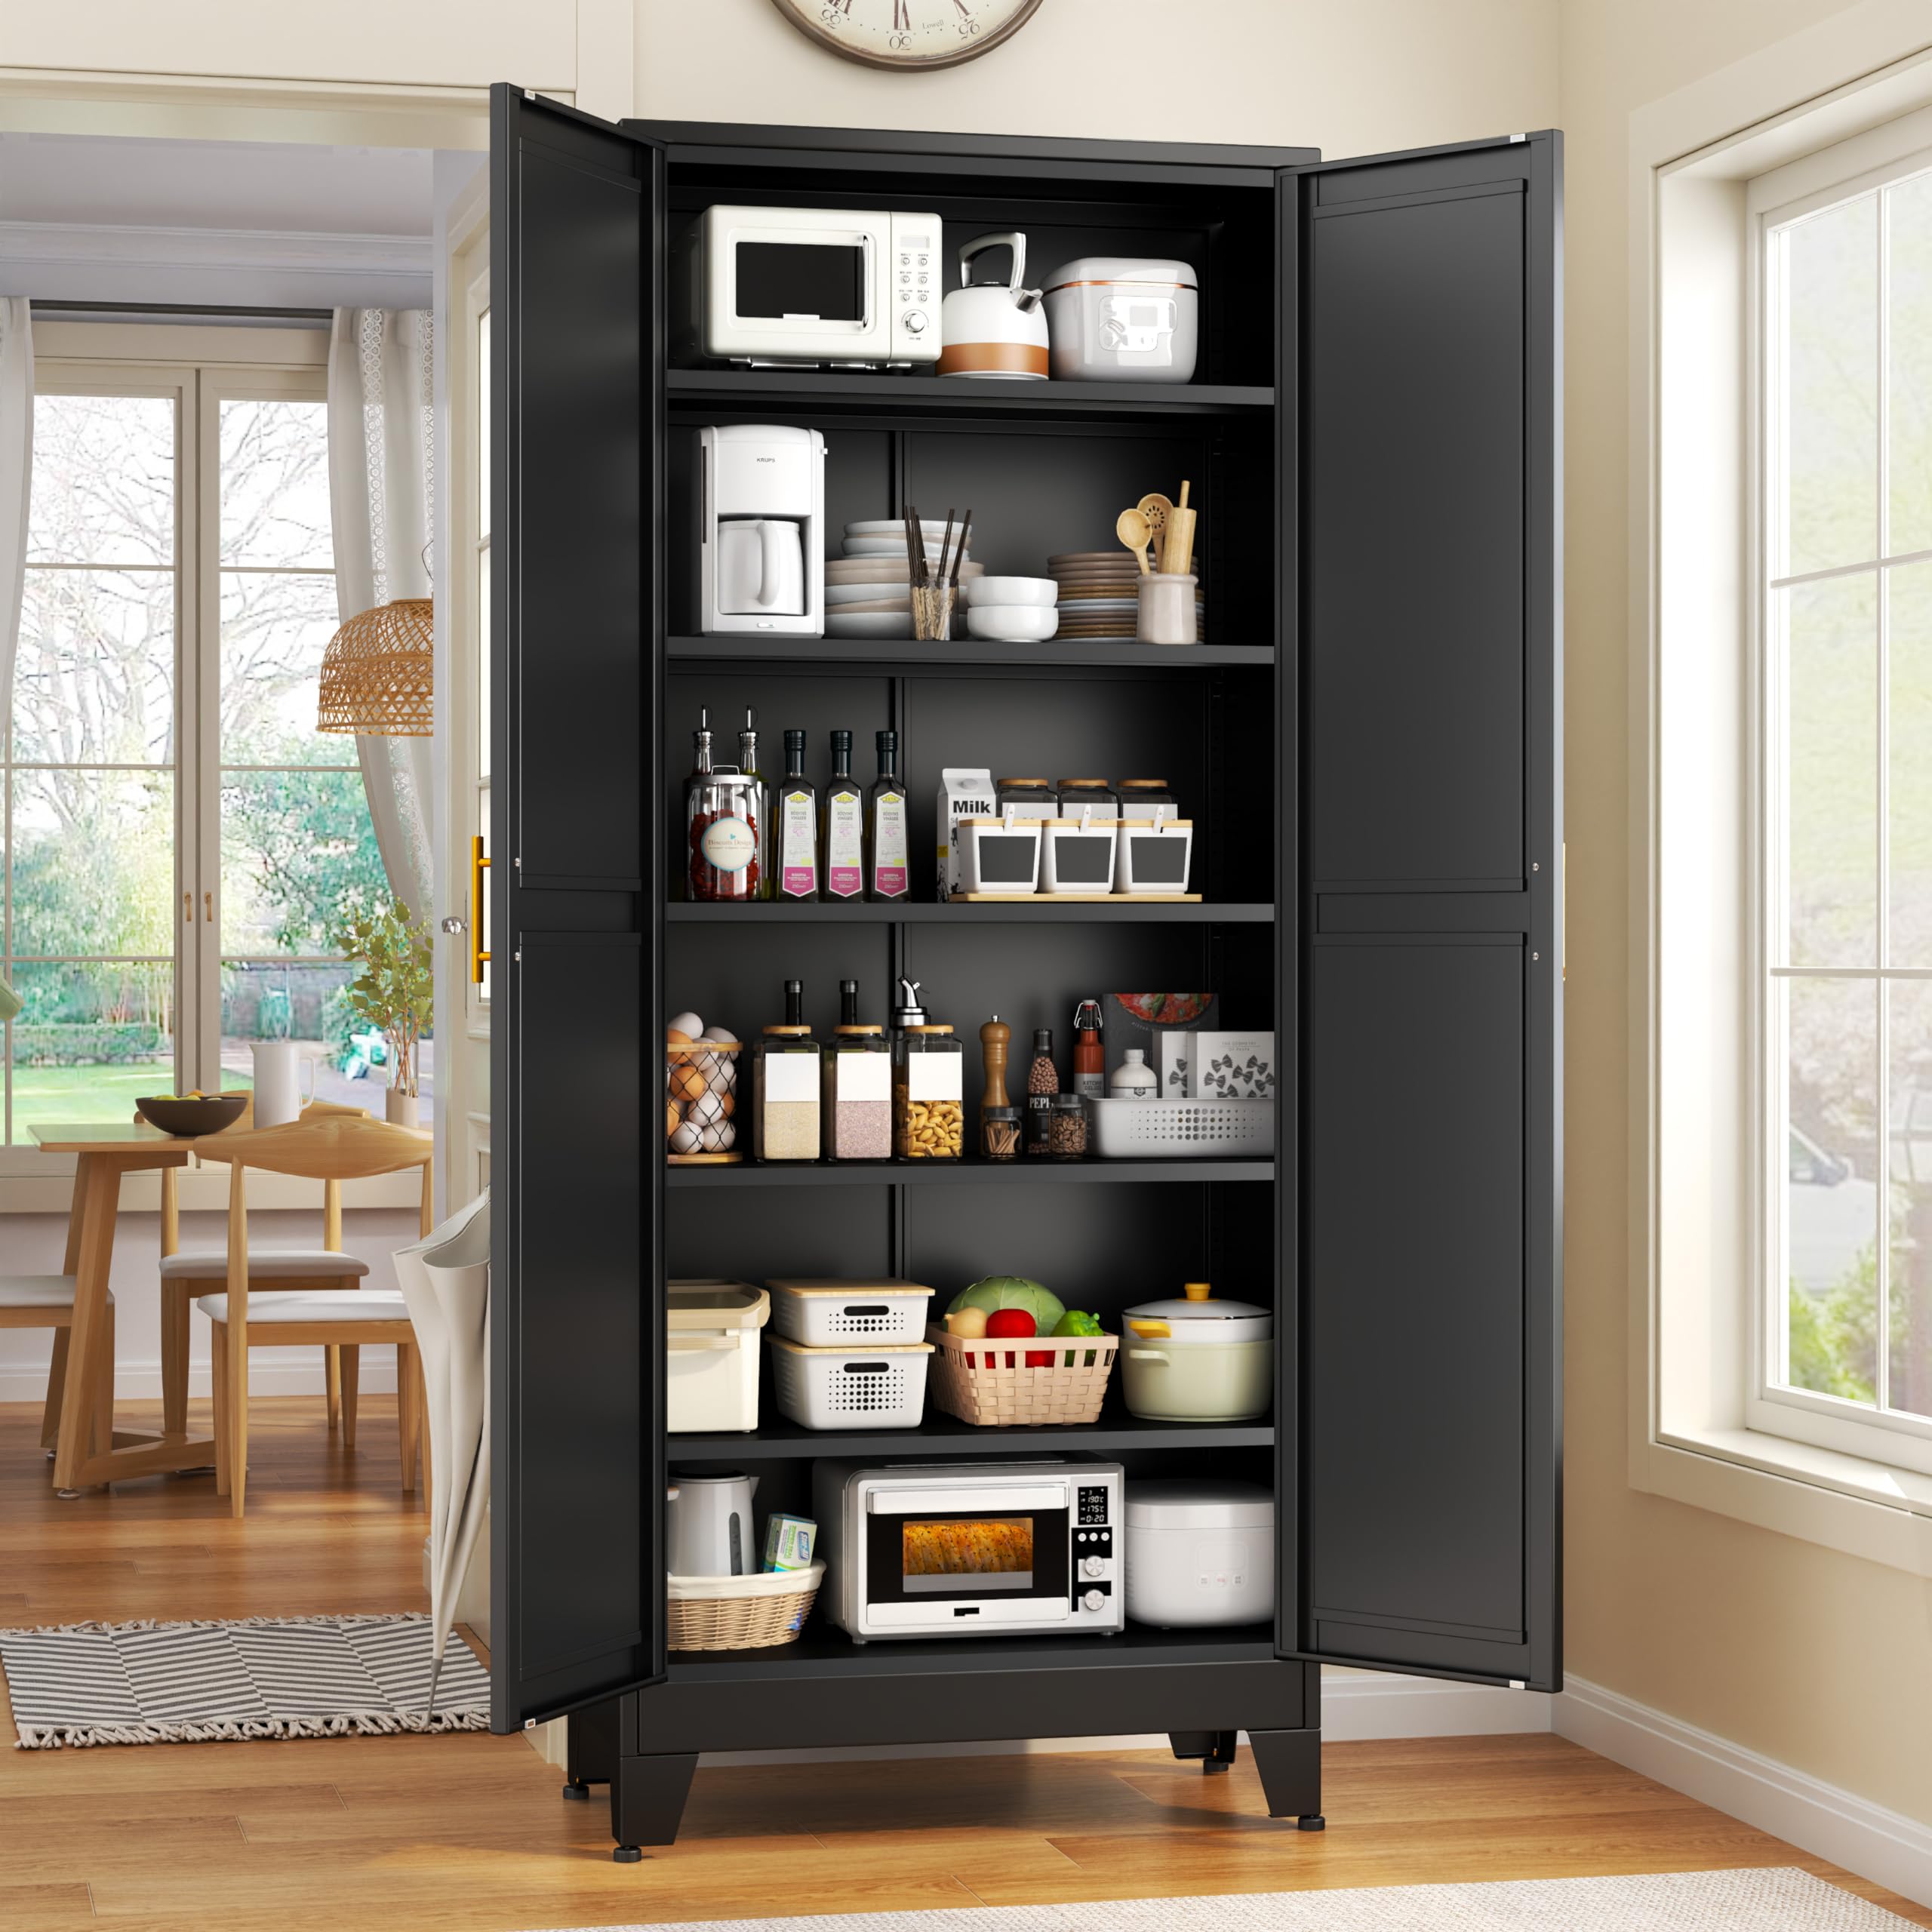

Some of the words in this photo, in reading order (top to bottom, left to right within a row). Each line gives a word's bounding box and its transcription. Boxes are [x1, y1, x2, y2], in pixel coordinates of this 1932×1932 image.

[921, 19, 945, 29] Lowell
[889, 35, 912, 51] 30
[953, 801, 991, 814] Milk
